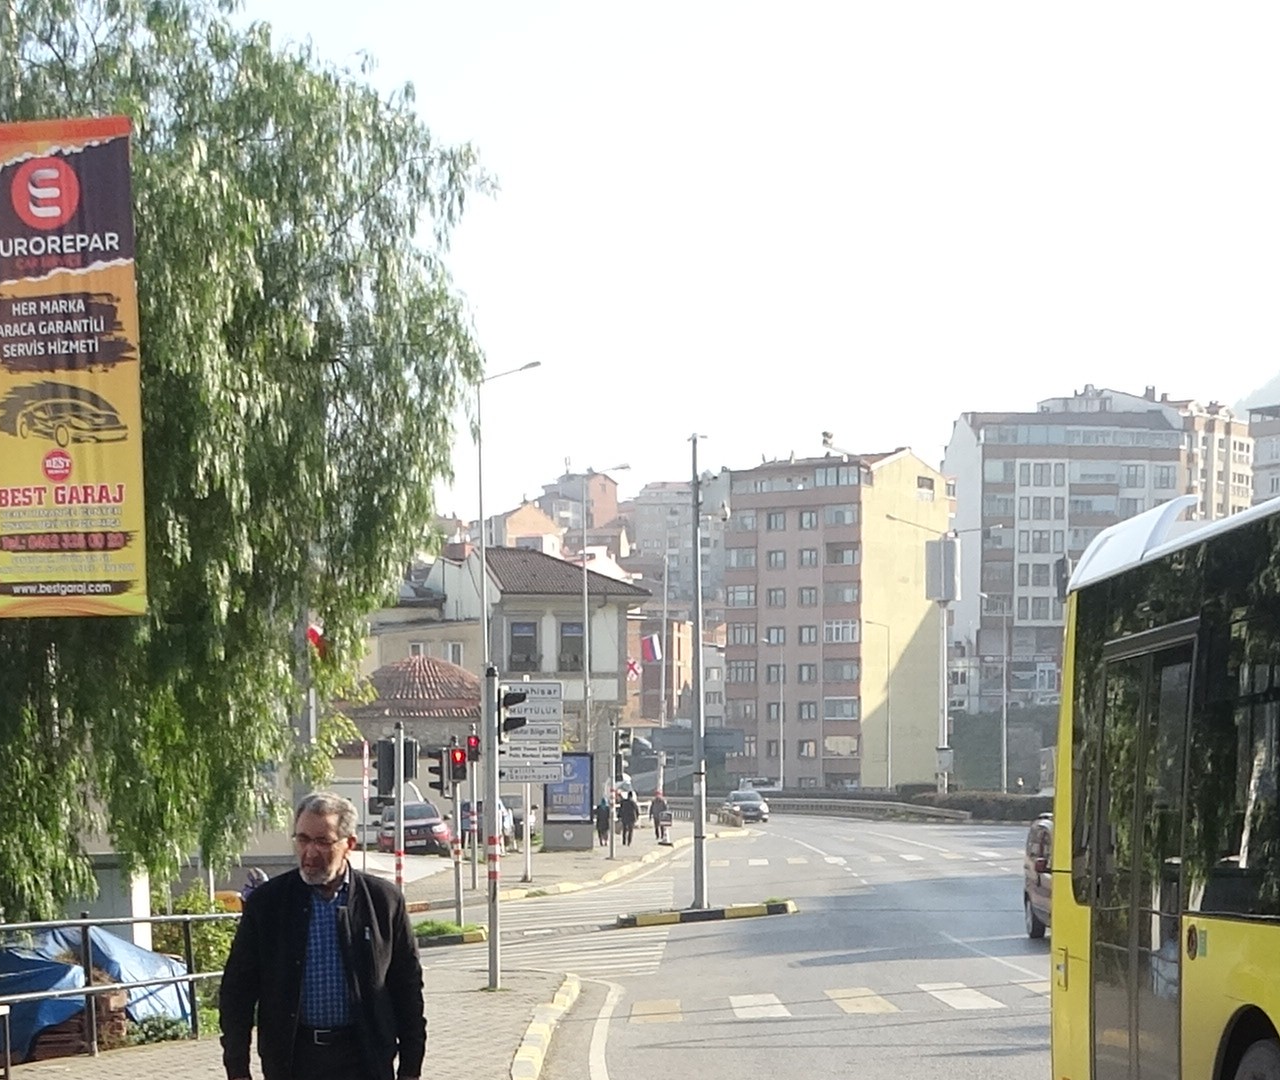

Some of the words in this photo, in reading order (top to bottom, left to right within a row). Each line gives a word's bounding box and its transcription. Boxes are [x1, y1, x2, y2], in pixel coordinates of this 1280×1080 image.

[11, 302, 38, 316] HER
[40, 299, 86, 315] MARKA
[38, 316, 104, 334] GARANTİLİ
[3, 339, 45, 358] SERVİS
[47, 337, 99, 355] HİZMETİ
[45, 457, 71, 469] BEST
[54, 484, 125, 506] GARAJ
[12, 581, 112, 596] www.bestgaraj.com
[509, 706, 558, 715] MÜFTÜLÜK
